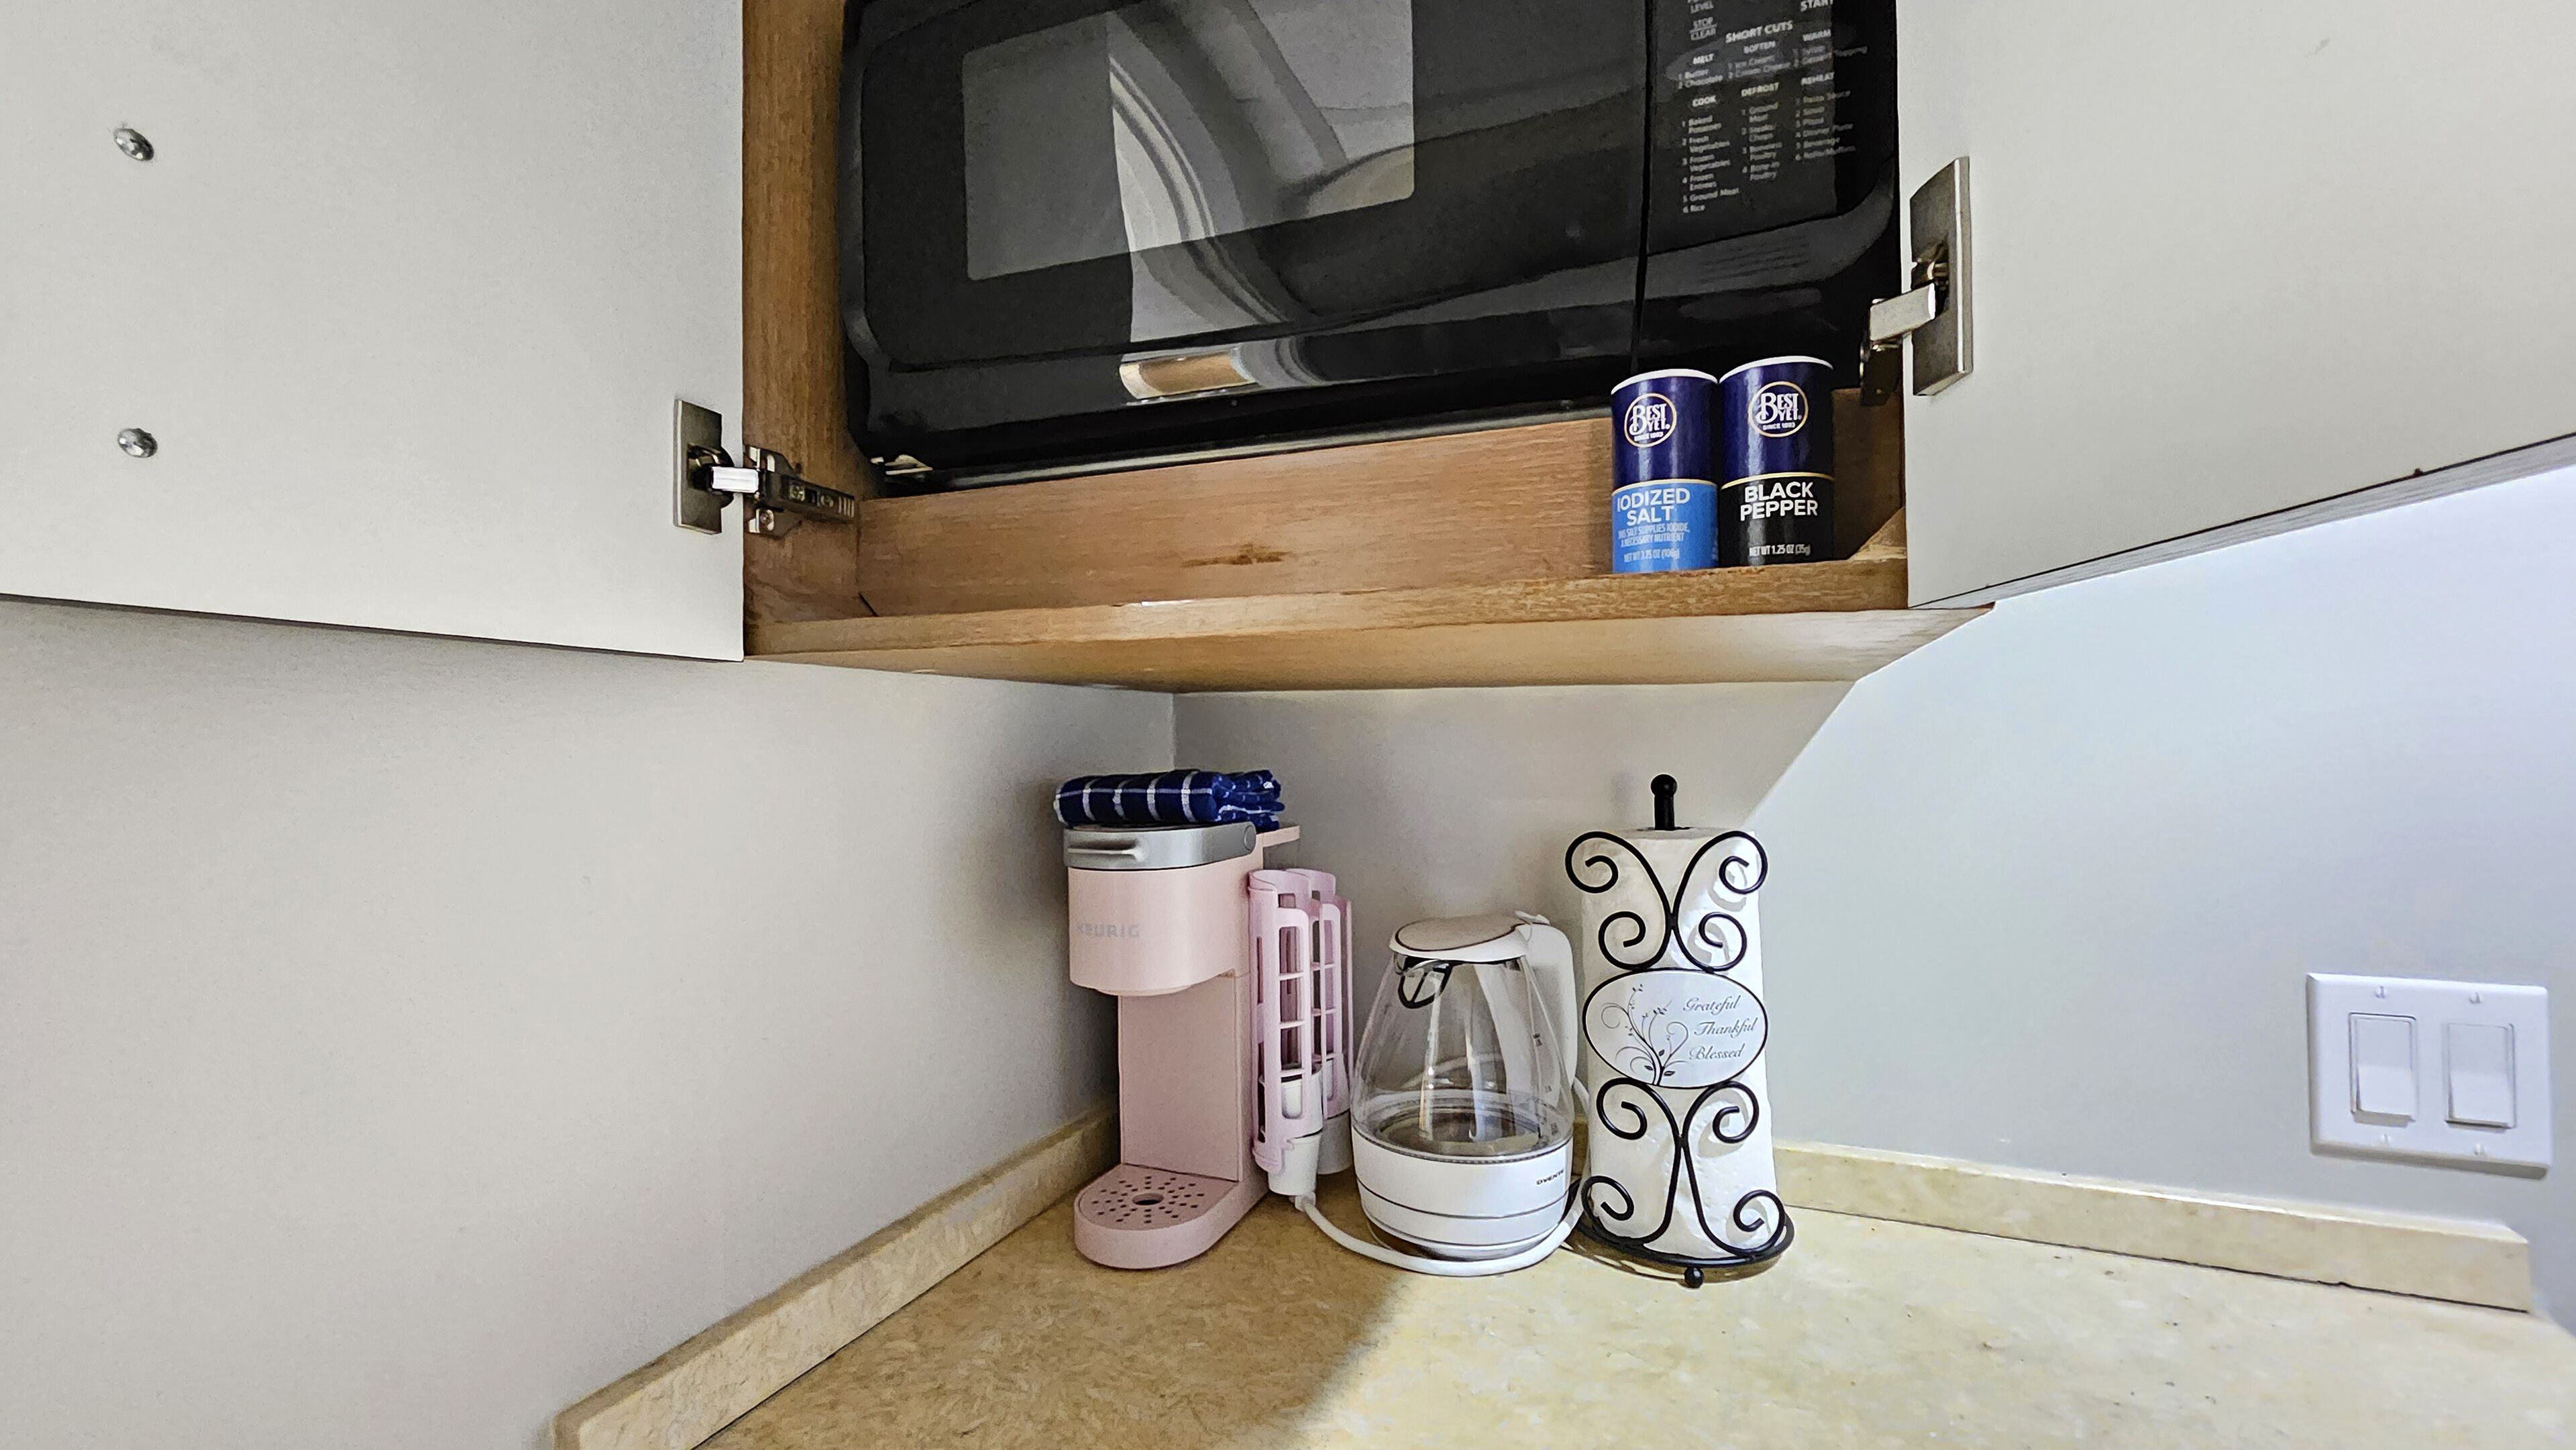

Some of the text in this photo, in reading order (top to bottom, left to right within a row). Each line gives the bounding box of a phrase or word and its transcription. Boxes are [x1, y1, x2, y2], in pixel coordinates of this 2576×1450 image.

[1693, 17, 1714, 30] STOP
[1690, 28, 1717, 40] CLEAR
[1725, 20, 1793, 43] SHORT CUTS
[1802, 29, 1831, 42] WARM
[1743, 40, 1776, 54] SOFTEN
[1693, 53, 1715, 64] MELT
[1801, 71, 1835, 86] REHEAT
[1741, 82, 1779, 97] DEFROST
[1692, 95, 1717, 107] COOK
[1689, 190, 1719, 202] Ground
[1720, 187, 1739, 197] Meat
[1690, 204, 1706, 213] Rice
[1754, 392, 1799, 424] BEST
[1629, 403, 1667, 435] BEST
[1744, 482, 1814, 503] BLACK
[1617, 488, 1690, 513] IODIZED
[1626, 505, 1675, 526] SALT
[1740, 499, 1819, 521] PEPPER
[1638, 523, 1666, 535] SUPPLIES
[1654, 532, 1685, 542] NUTRIENT
[1623, 552, 1632, 562] NET
[1652, 548, 1661, 559] OZ
[1749, 546, 1761, 557] NET
[1761, 545, 1771, 556] WT
[1771, 544, 1785, 555] 1.25
[1786, 543, 1795, 554] OZ
[1076, 923, 1139, 938] KEURIG
[1682, 995, 1741, 1015] Grateful
[1694, 1018, 1758, 1038] Thankful
[1688, 1043, 1746, 1060] Blessed
